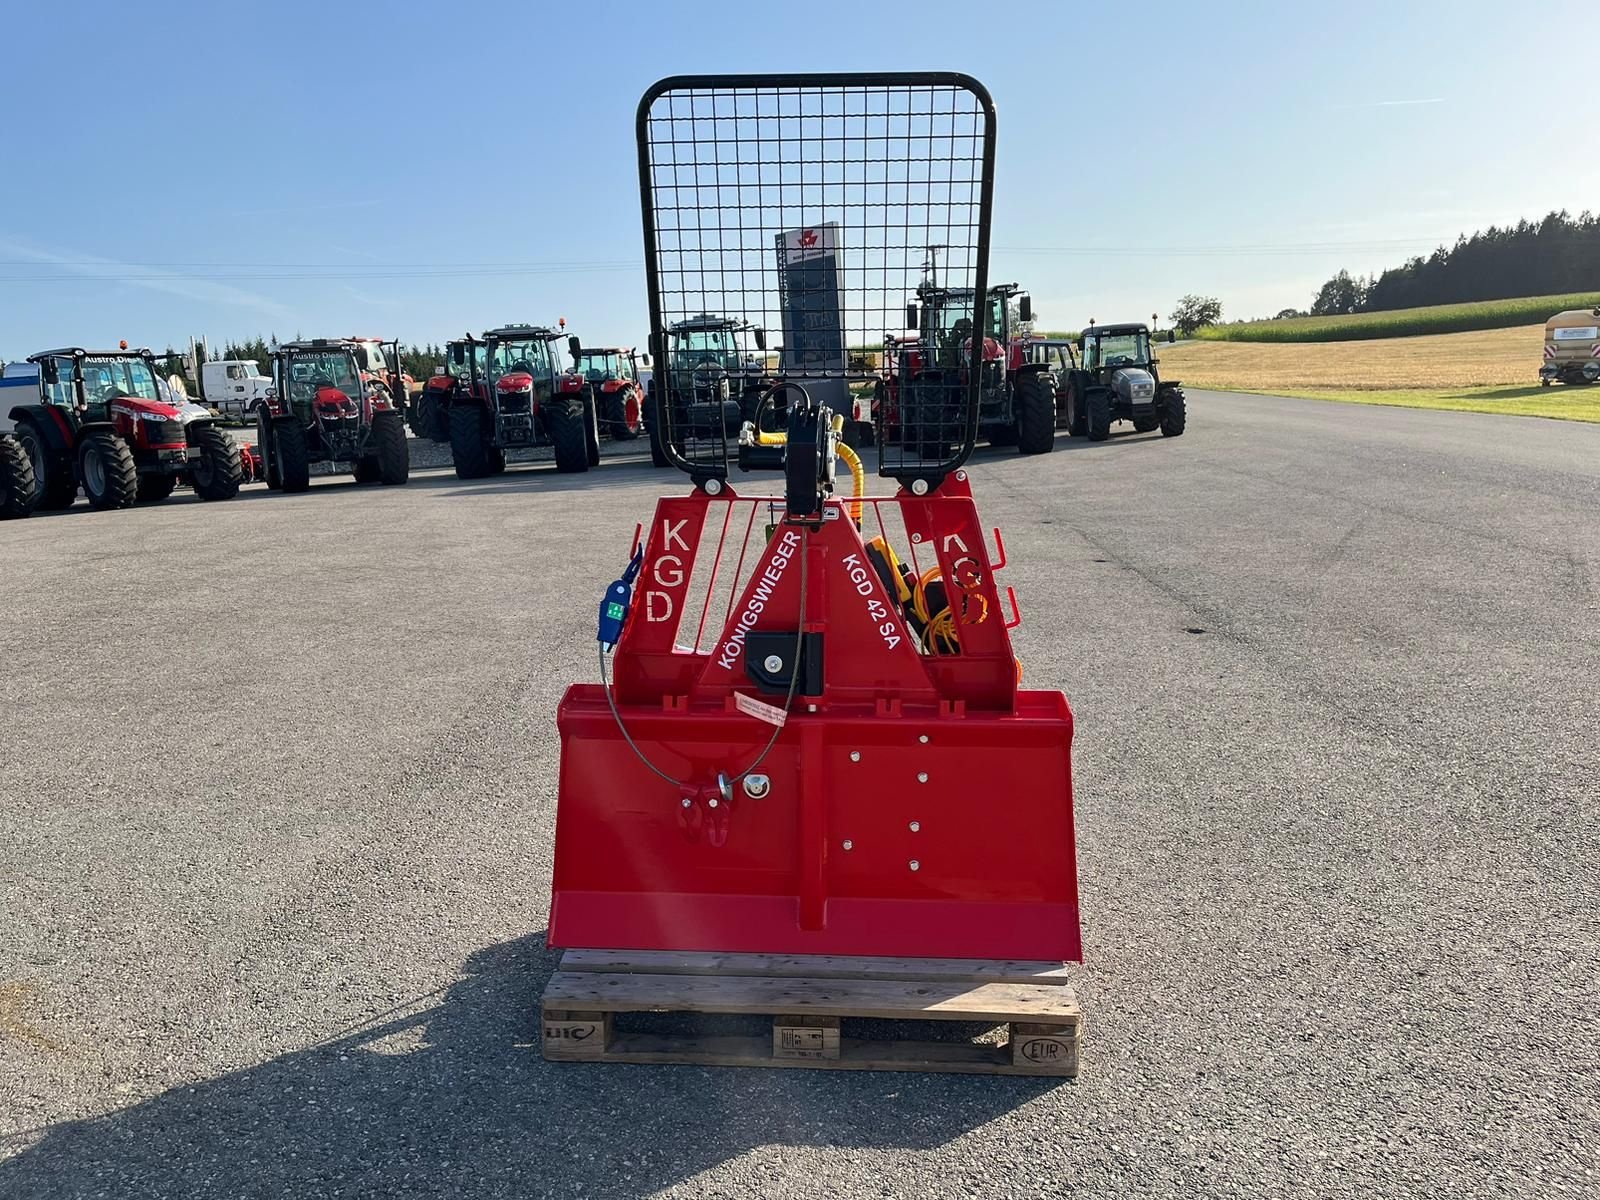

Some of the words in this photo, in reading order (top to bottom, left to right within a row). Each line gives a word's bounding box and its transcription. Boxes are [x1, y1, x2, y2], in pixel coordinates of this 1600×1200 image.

[84, 356, 115, 364] Austro
[292, 352, 320, 360] Austro
[321, 351, 348, 359] Diesel
[646, 519, 690, 622] KGD
[717, 530, 801, 670] KÖNIGSWIESER
[842, 553, 874, 596] KGD
[867, 599, 887, 622] 42
[879, 622, 901, 650] SA
[1031, 1042, 1058, 1059] EUR
